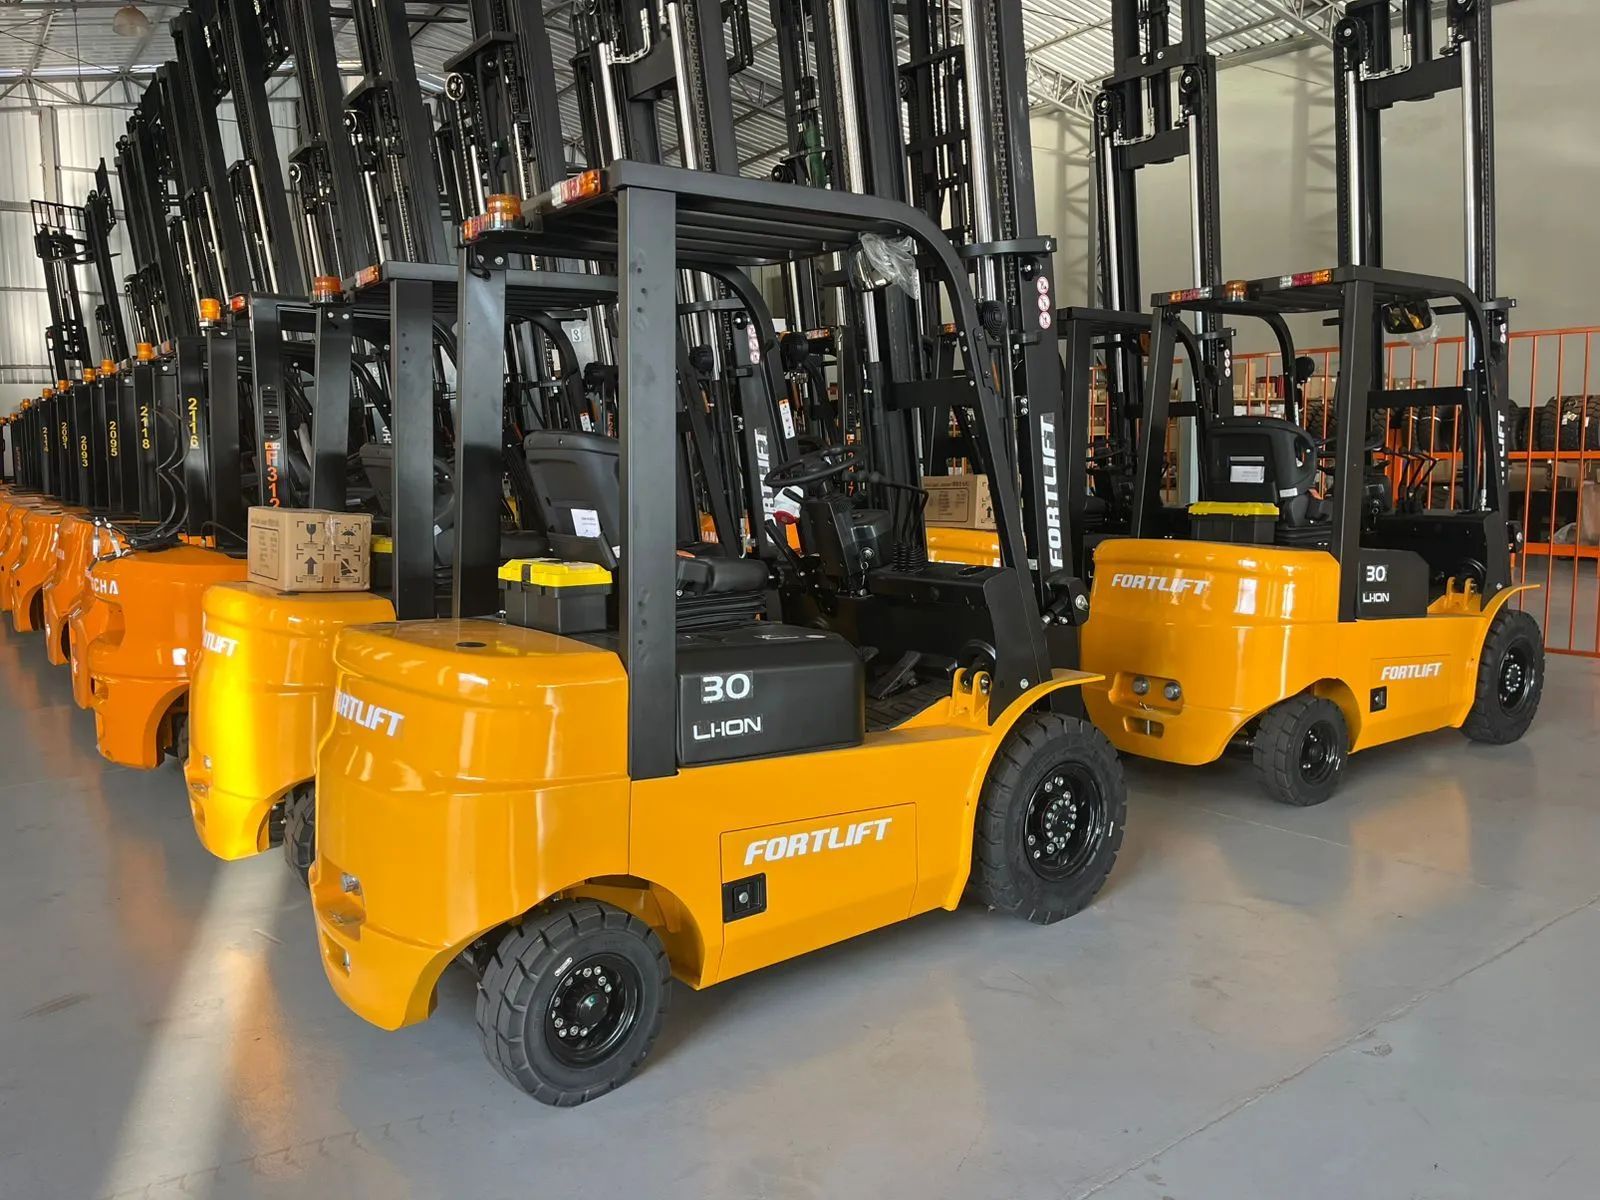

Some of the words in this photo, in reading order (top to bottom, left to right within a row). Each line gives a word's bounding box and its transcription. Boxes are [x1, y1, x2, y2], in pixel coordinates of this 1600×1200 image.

[109, 421, 118, 457] 2095
[140, 406, 150, 449] 2118
[187, 398, 199, 448] 2116
[80, 435, 88, 467] 2093
[1040, 415, 1063, 568] FORTLIFT
[1112, 573, 1209, 595] FORTLIFT
[1366, 565, 1386, 582] 30
[702, 673, 751, 702] 30
[1381, 662, 1442, 681] FORTLIFT
[693, 716, 761, 740] LI-ION
[743, 817, 893, 866] FORTLIFT
